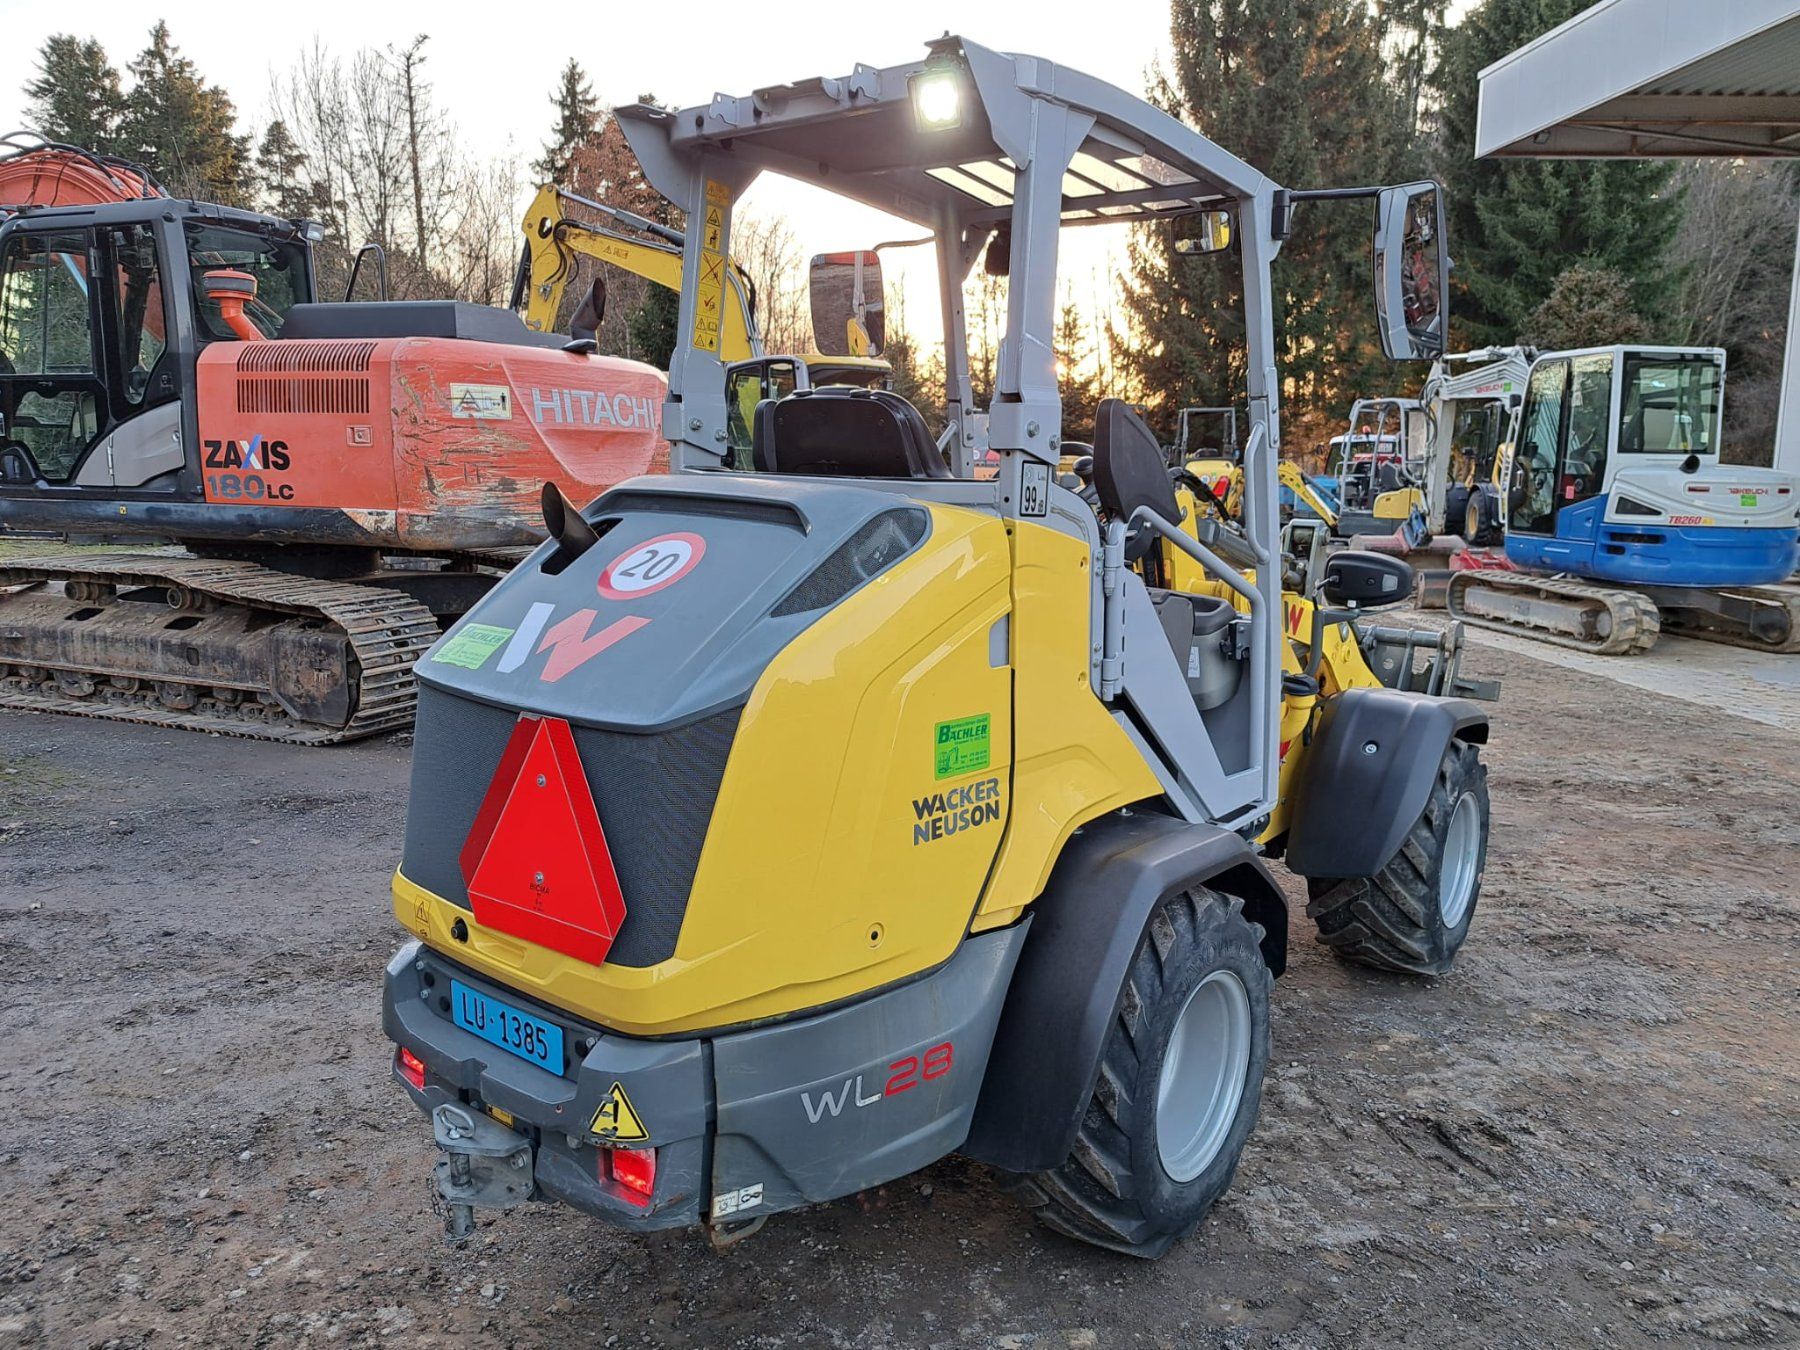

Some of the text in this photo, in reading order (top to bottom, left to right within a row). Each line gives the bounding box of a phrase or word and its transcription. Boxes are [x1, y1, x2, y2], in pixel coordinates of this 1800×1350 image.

[531, 387, 656, 430] HITACHI
[203, 434, 291, 471] ZAXIS
[1024, 485, 1037, 513] 99
[1668, 515, 1702, 525] TB260
[618, 549, 681, 581] 20
[911, 777, 1001, 821] WACKER
[913, 799, 1001, 846] NEUSON
